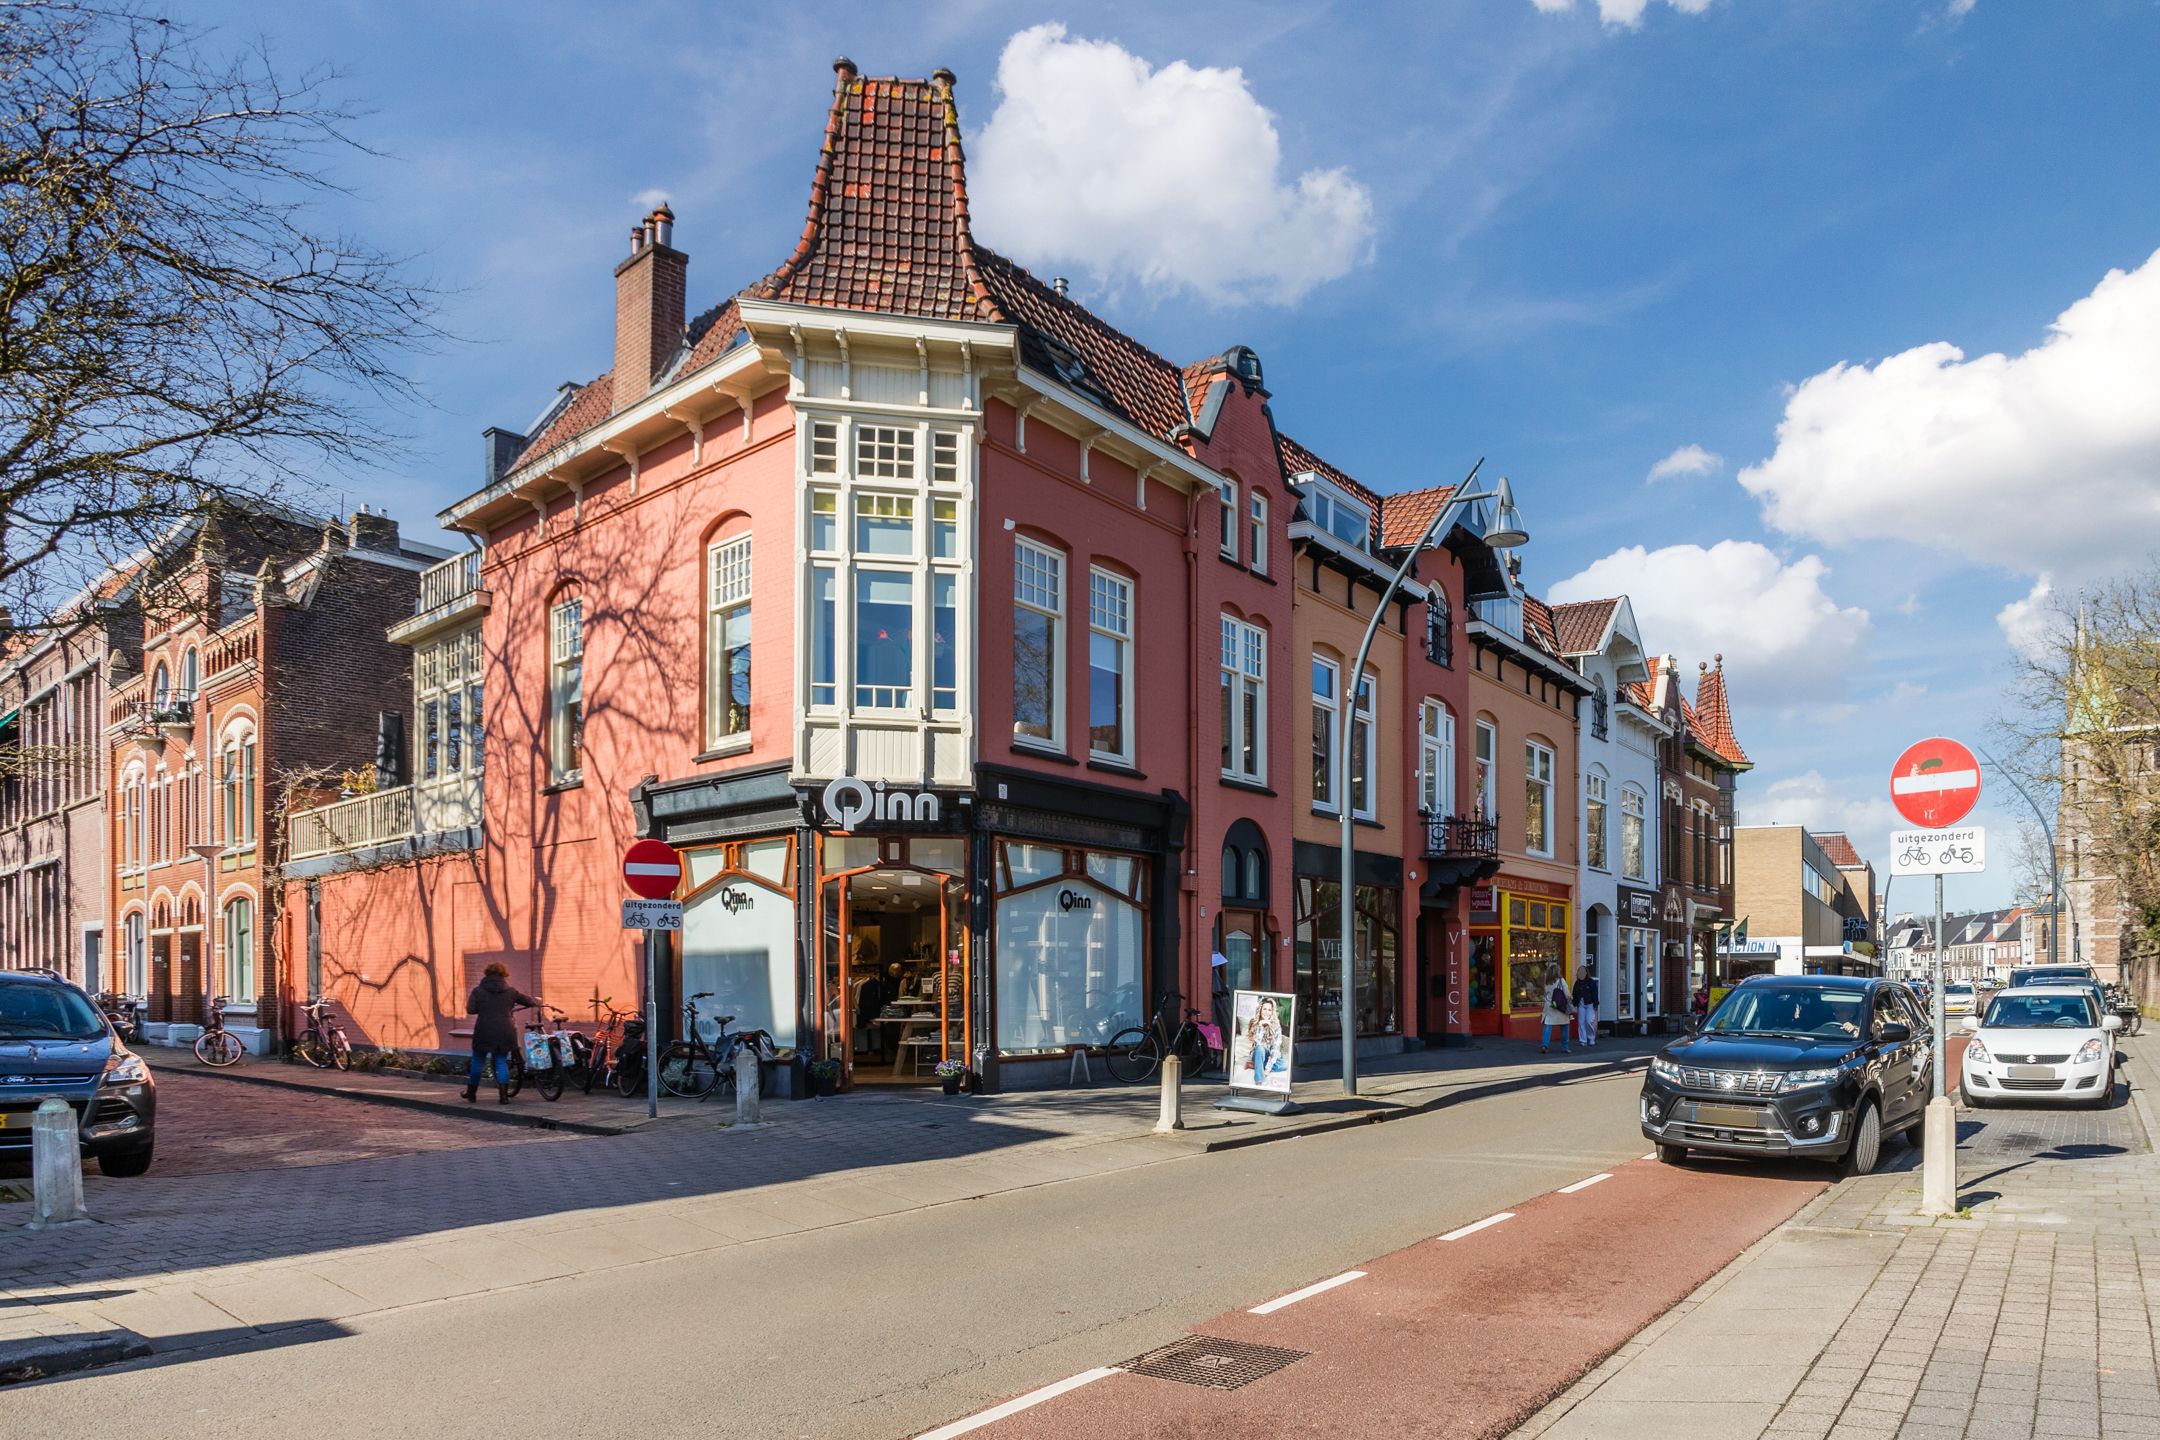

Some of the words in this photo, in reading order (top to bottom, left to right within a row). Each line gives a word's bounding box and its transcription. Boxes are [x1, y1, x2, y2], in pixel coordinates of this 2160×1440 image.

[823, 776, 939, 831] Qinn
[1898, 831, 1974, 845] uitgezonderd
[625, 901, 681, 910] uitgezonderd
[1060, 889, 1091, 912] Qinn
[1448, 931, 1460, 1025] VLECK
